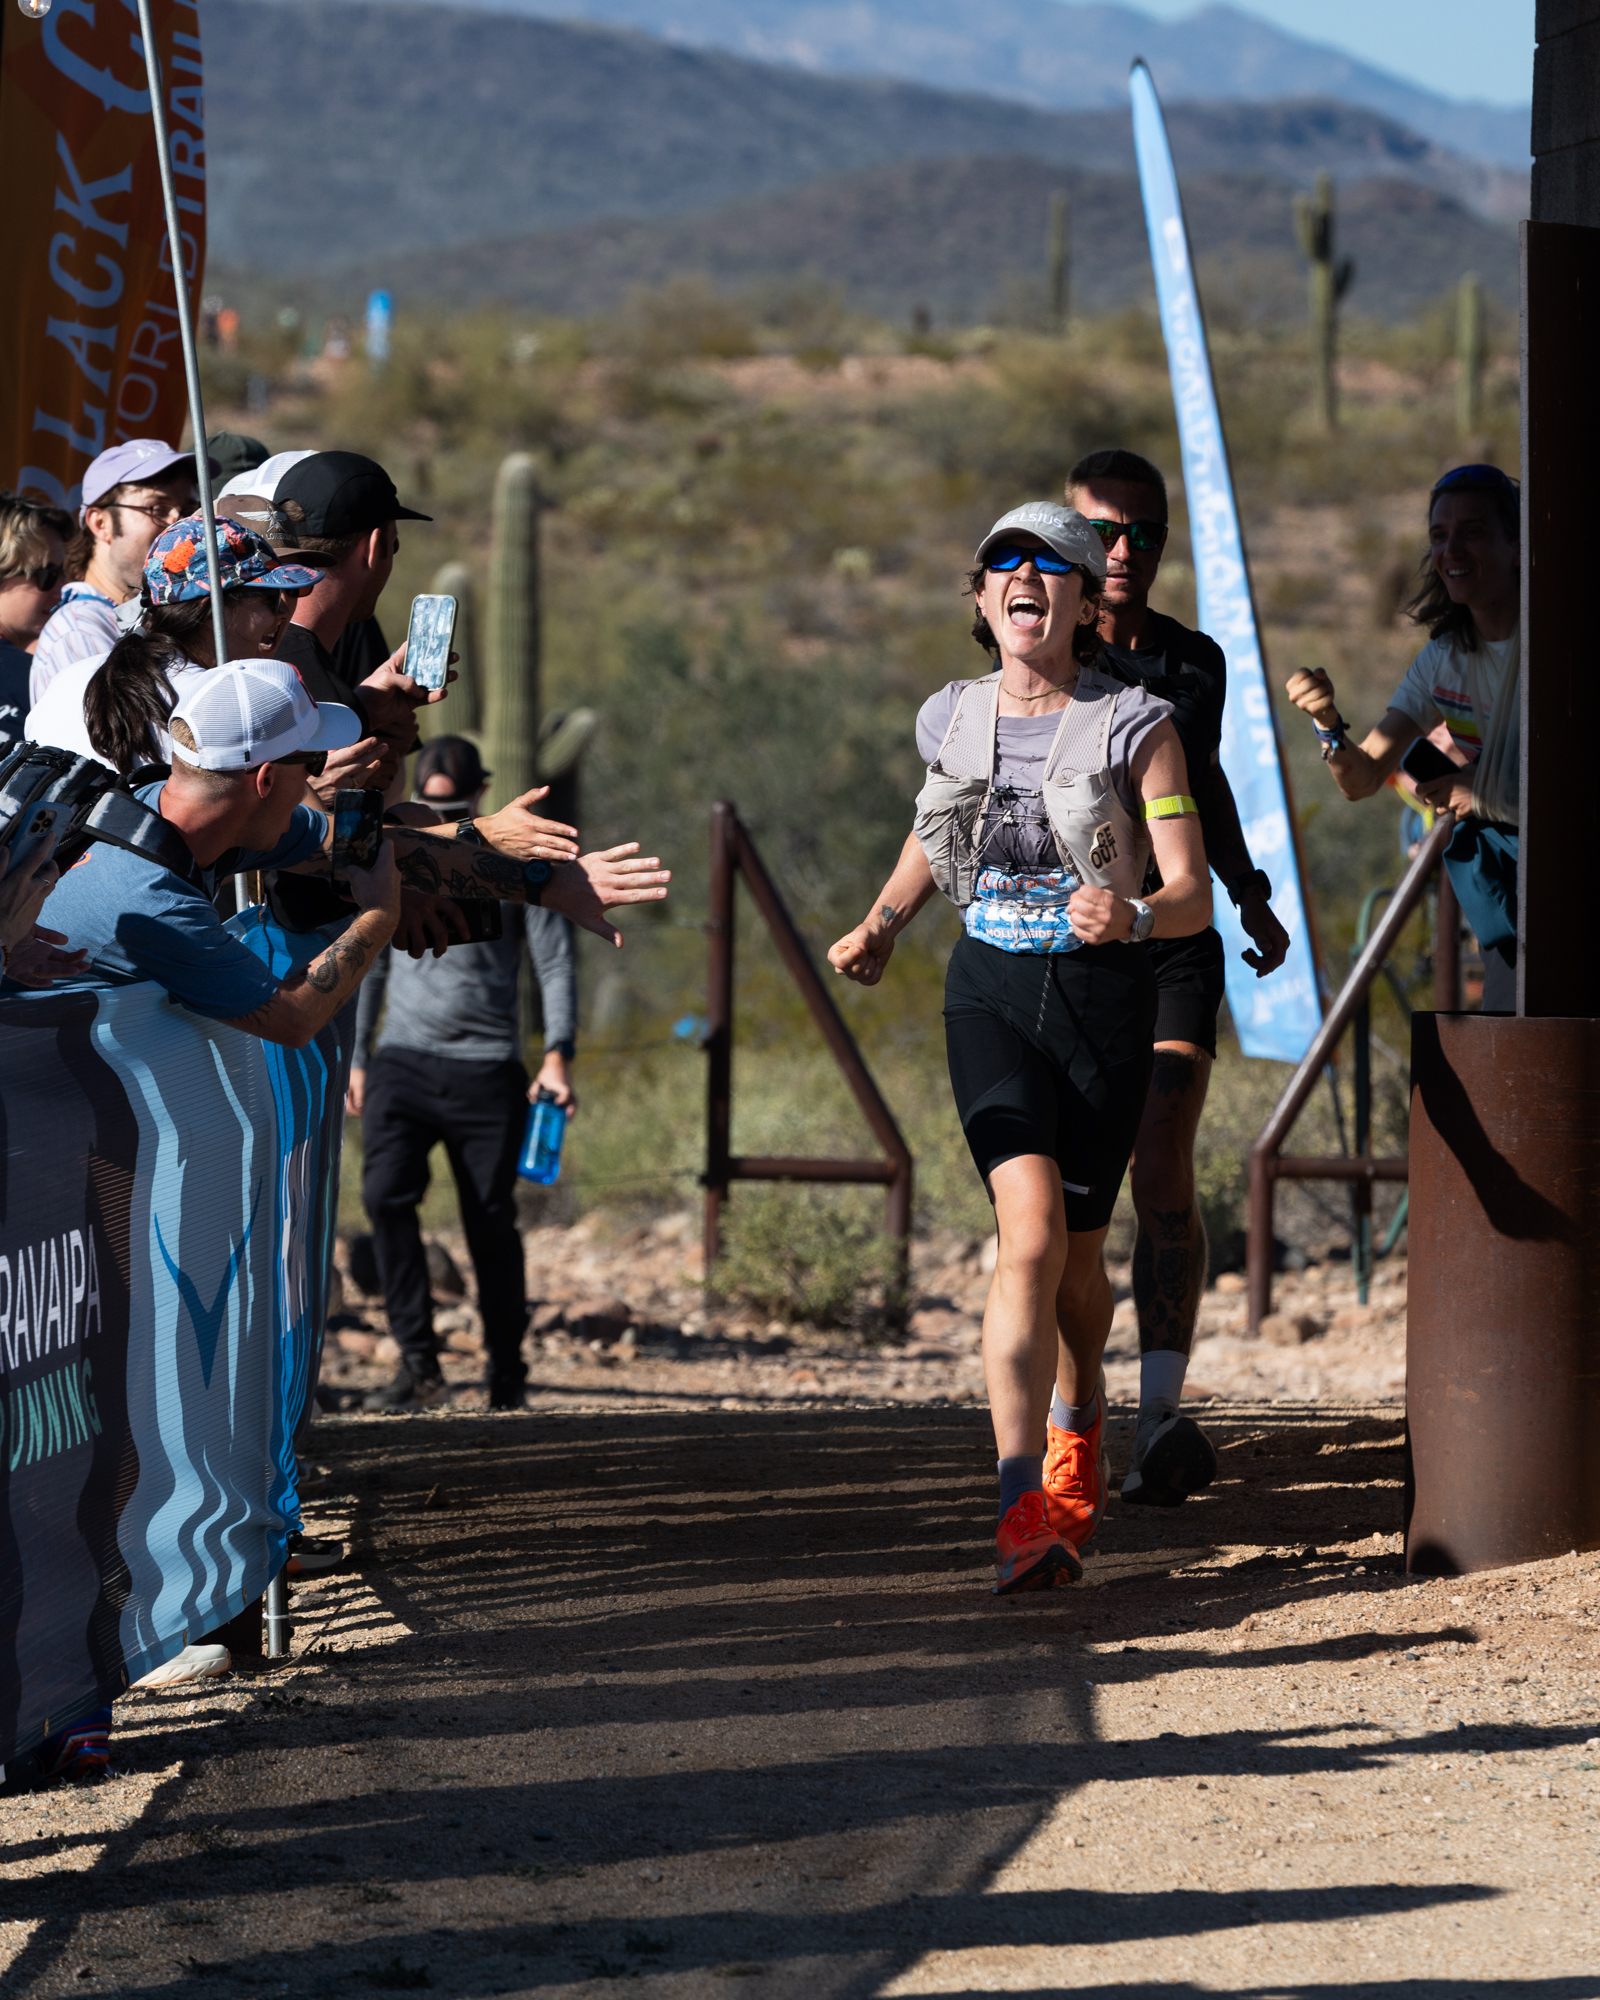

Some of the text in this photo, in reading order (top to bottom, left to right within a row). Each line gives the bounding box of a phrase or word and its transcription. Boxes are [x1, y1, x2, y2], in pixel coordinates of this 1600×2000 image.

[114, 230, 198, 441] ORLD
[1002, 512, 1064, 528] CELSIUS
[1091, 837, 1118, 869] OUT
[985, 928, 1018, 938] MOLLY
[0, 1357, 102, 1472] UNNING
